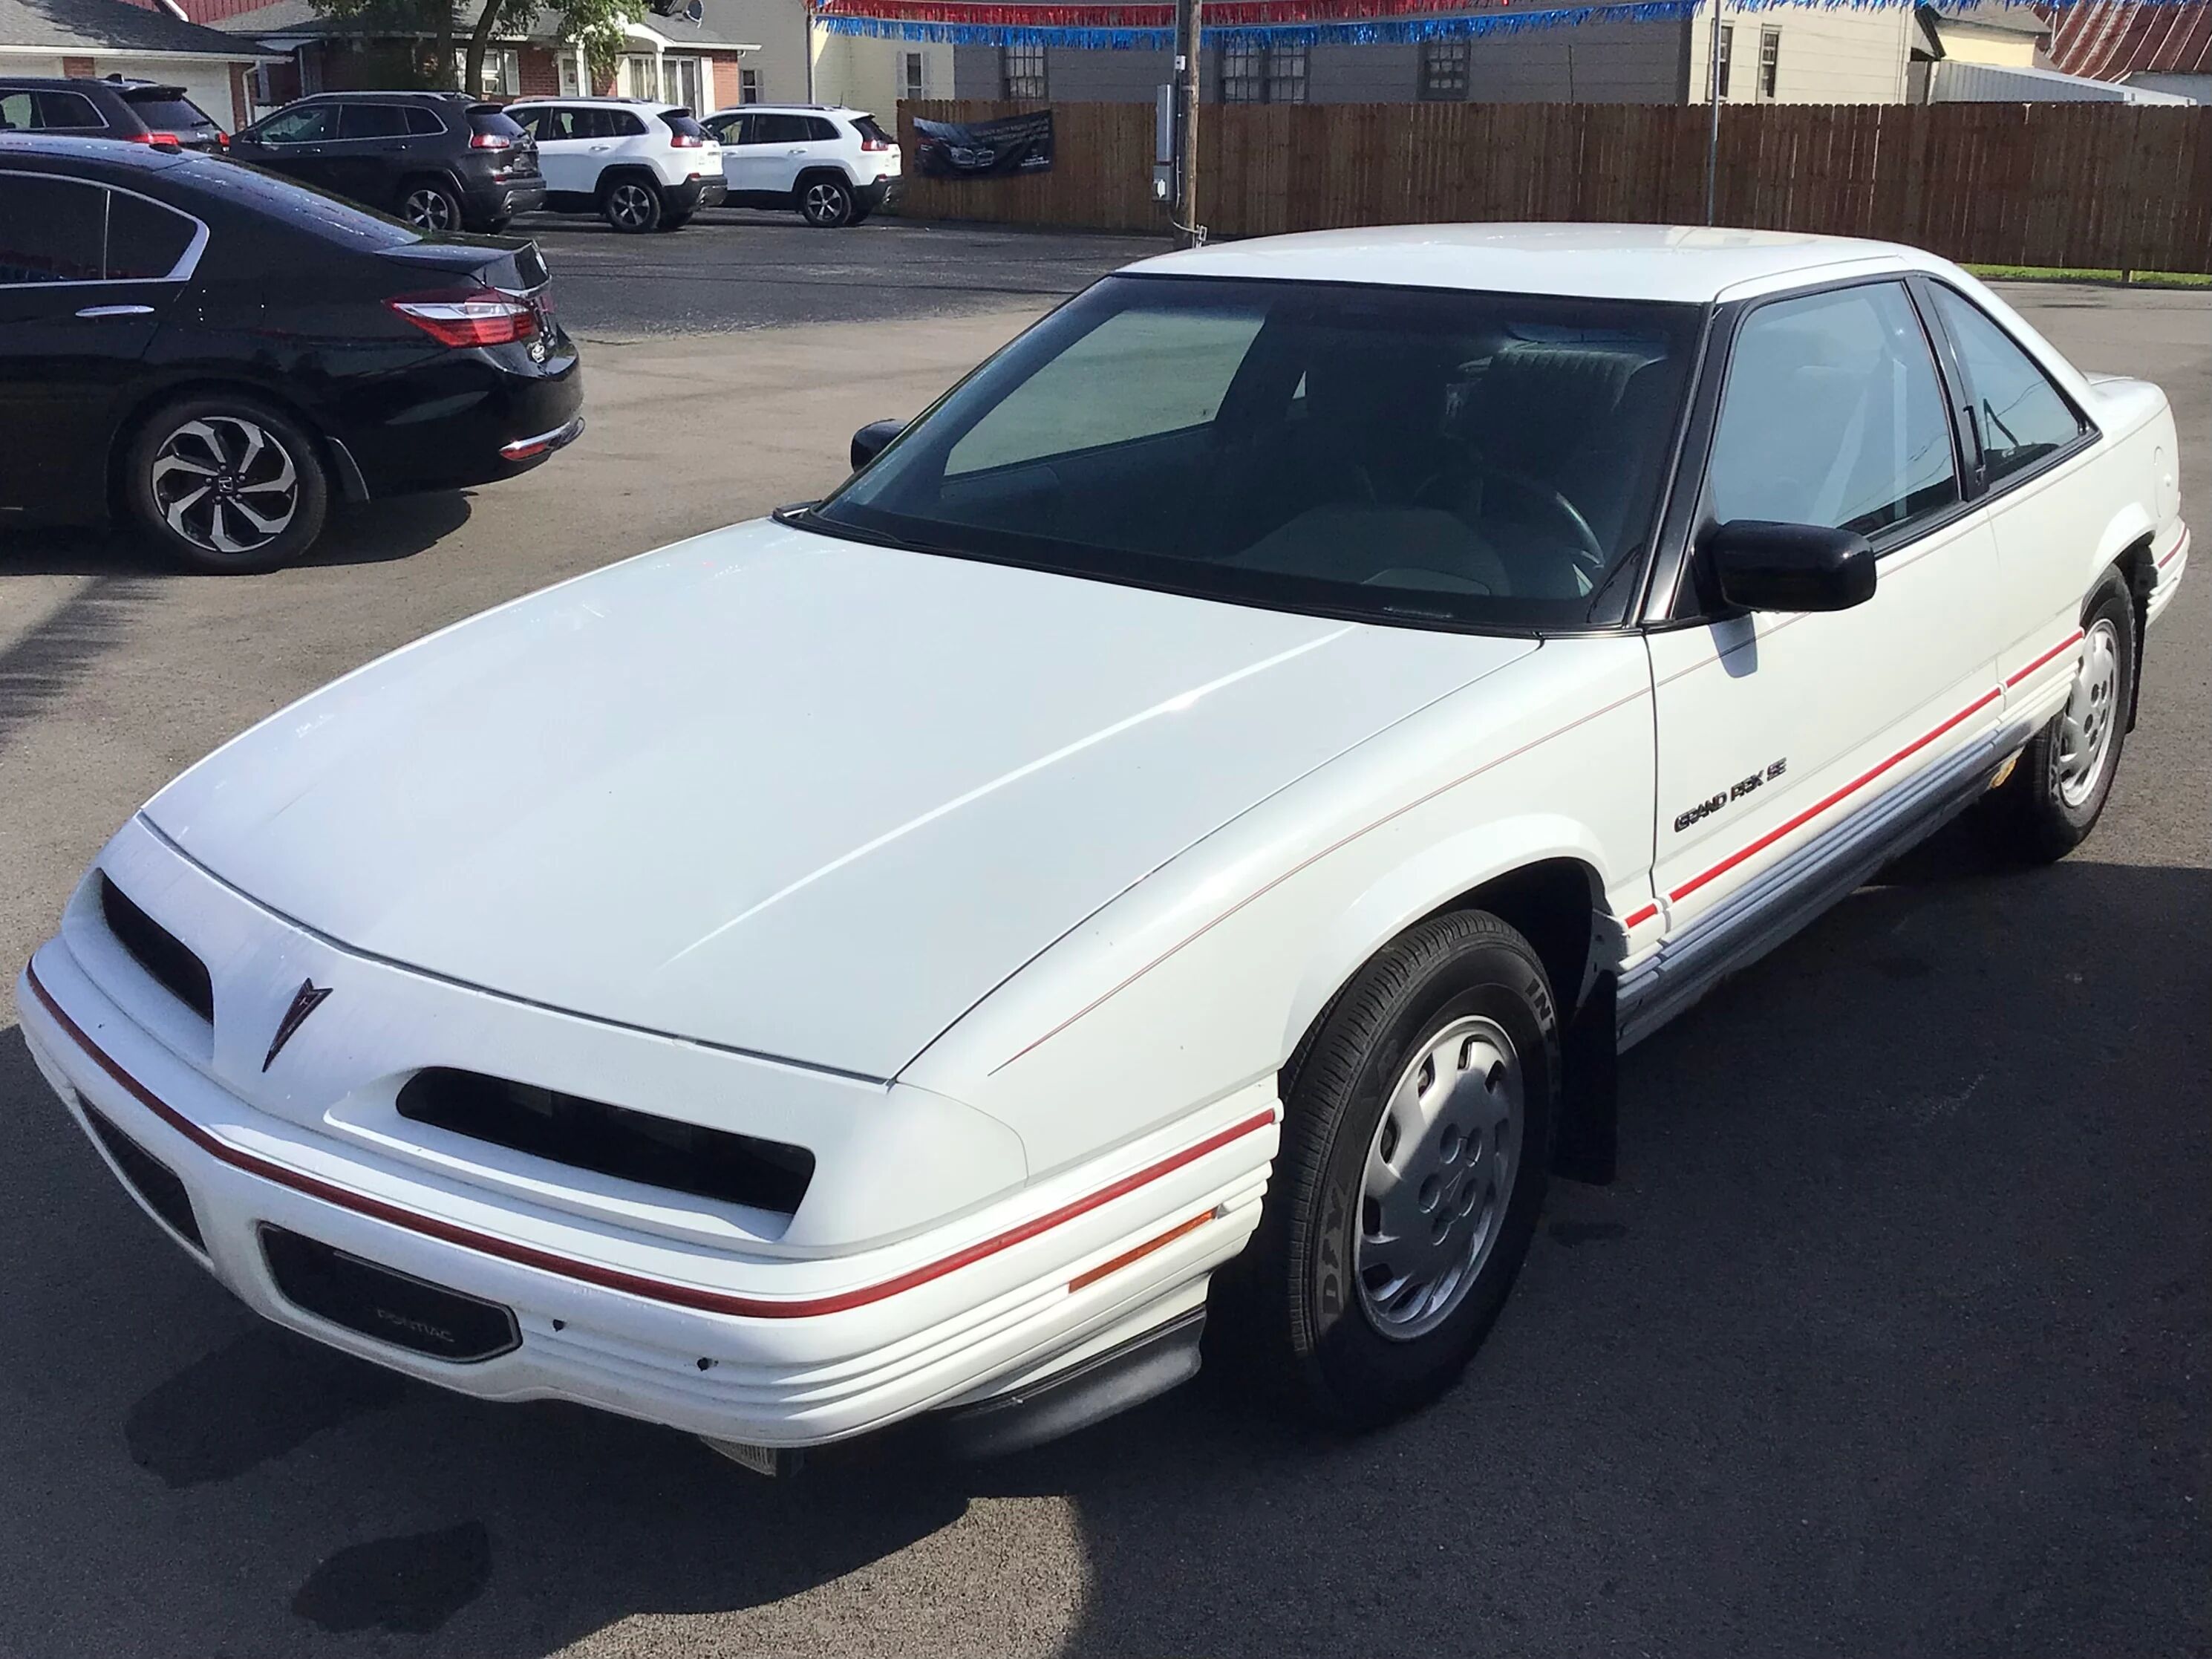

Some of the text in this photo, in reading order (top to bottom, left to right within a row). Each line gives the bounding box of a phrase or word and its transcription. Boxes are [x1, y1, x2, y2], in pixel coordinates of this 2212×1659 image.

[1674, 757, 1787, 832] GRAND PRIX SE
